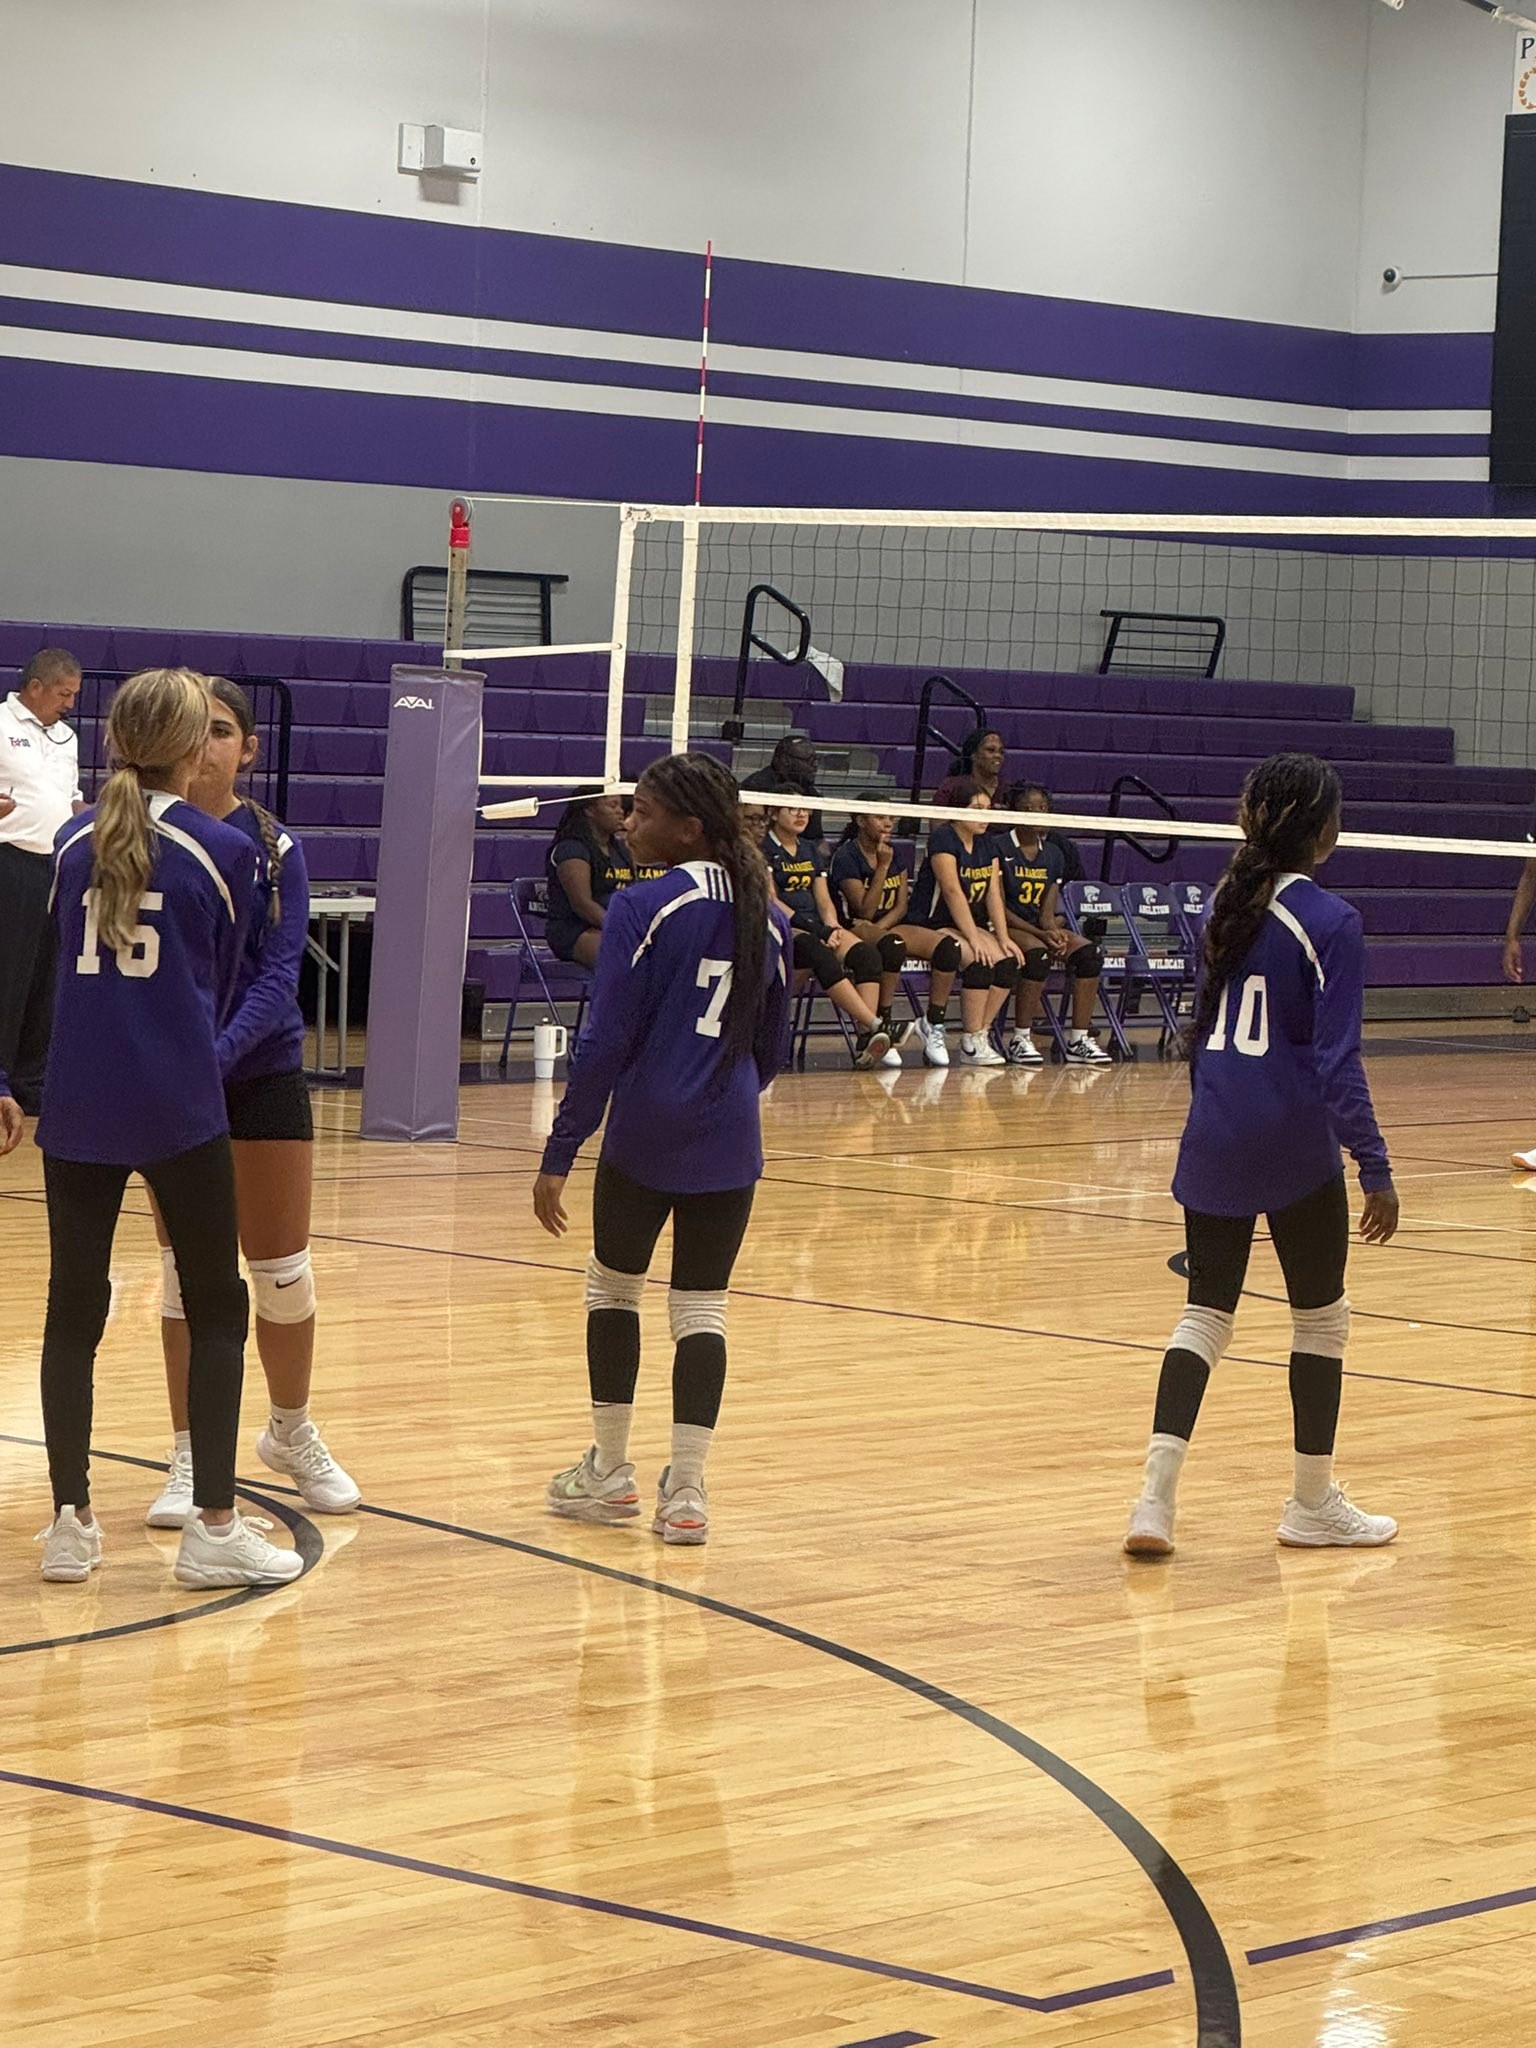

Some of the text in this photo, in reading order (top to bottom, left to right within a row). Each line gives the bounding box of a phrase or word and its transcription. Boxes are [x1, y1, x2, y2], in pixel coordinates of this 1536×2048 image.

[1520, 37, 1535, 60] P
[1015, 865, 1025, 877] LA
[1018, 881, 1045, 904] 37
[1148, 958, 1184, 970] WILDCATS
[695, 957, 733, 1038] 7
[1205, 975, 1270, 1057] 10
